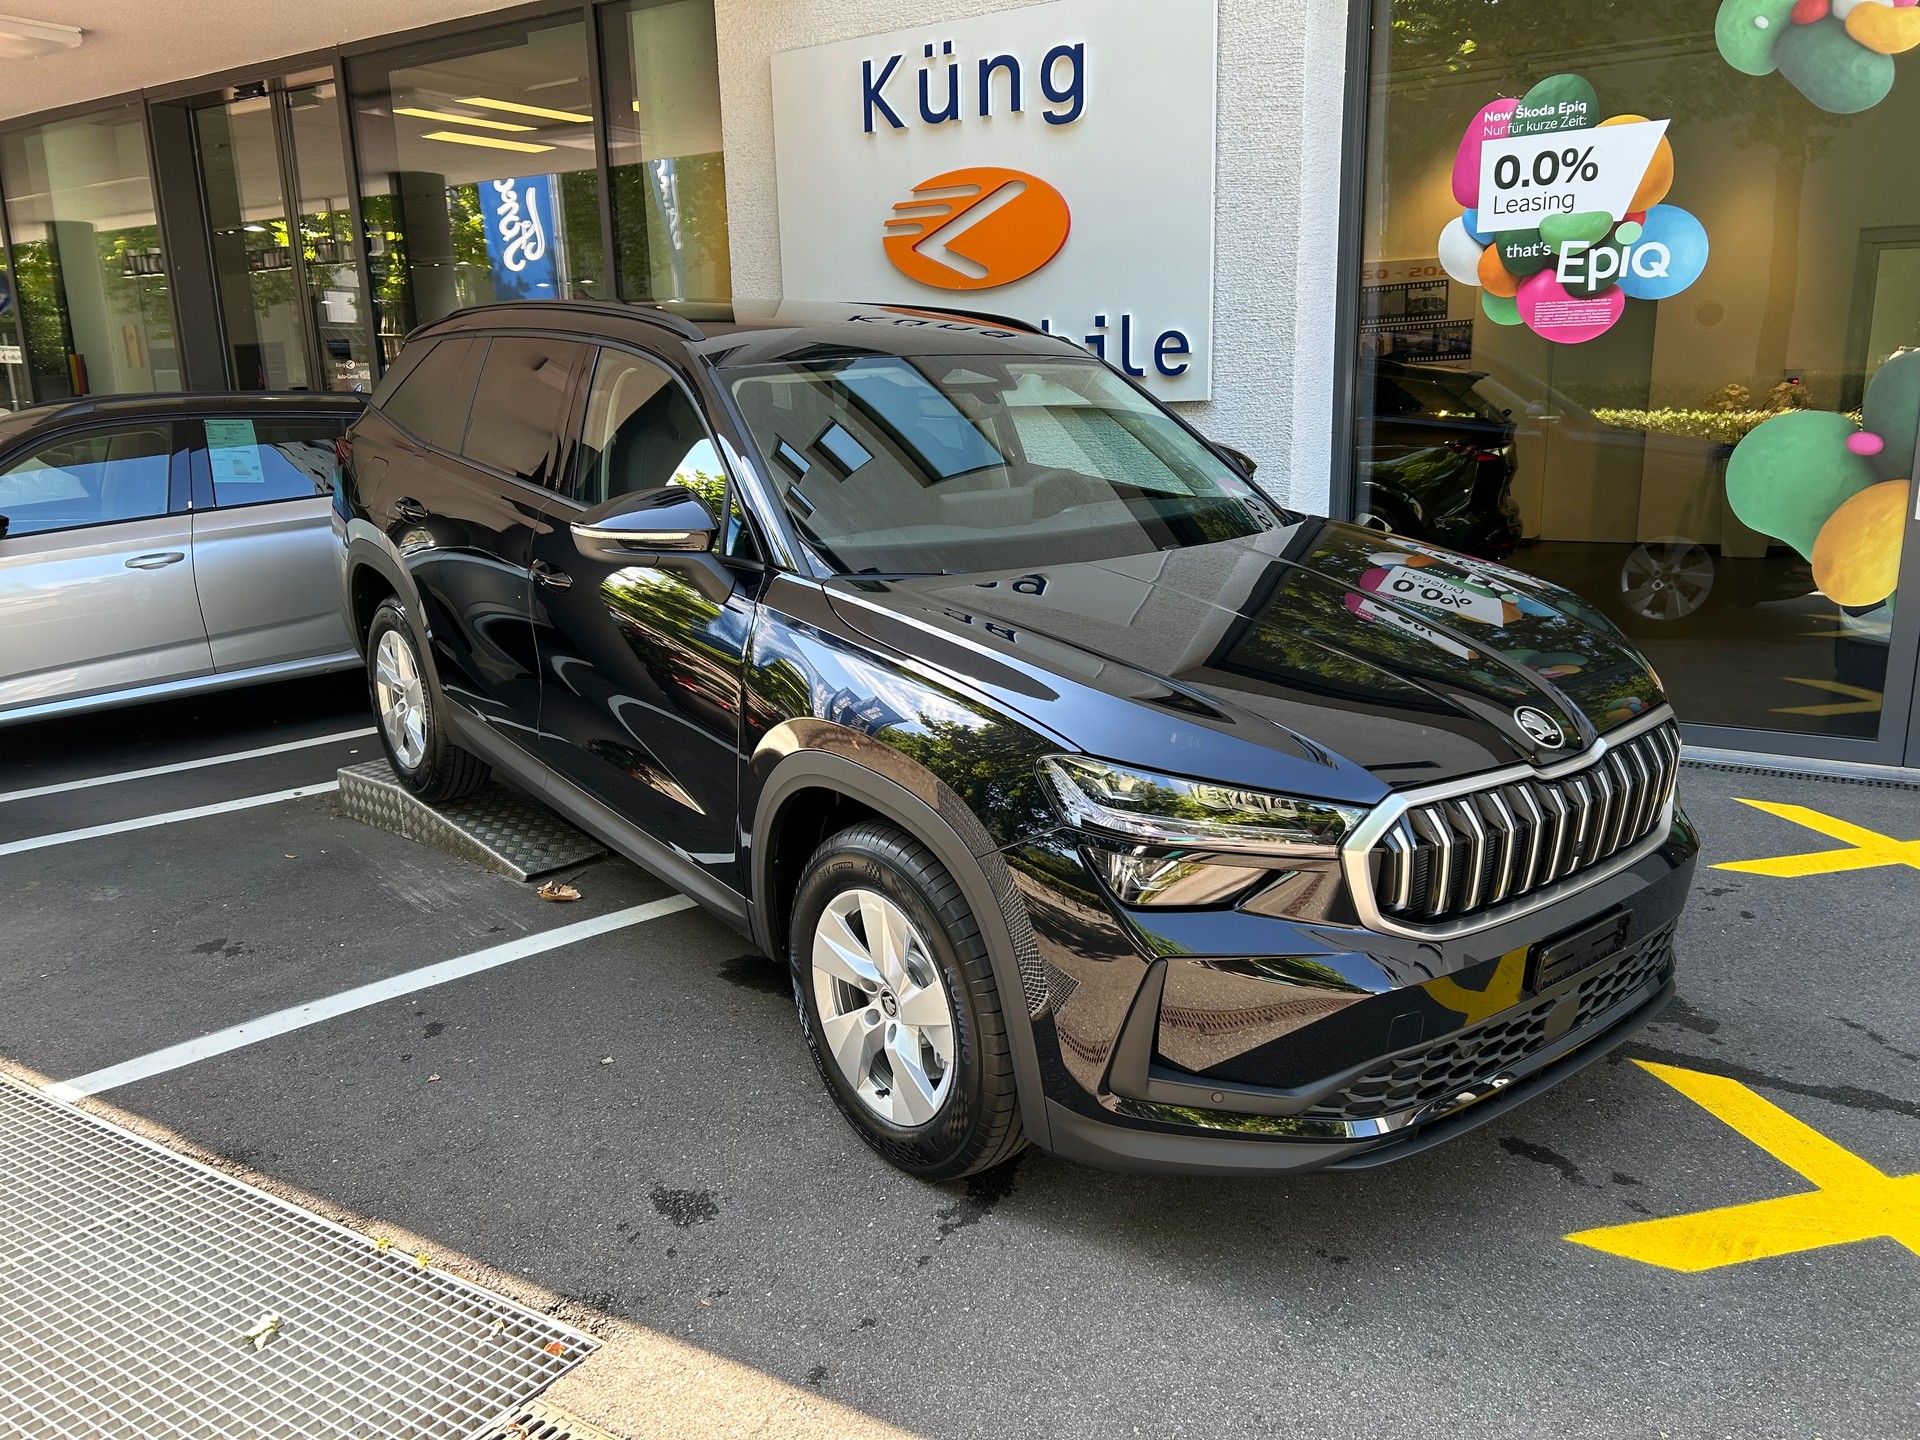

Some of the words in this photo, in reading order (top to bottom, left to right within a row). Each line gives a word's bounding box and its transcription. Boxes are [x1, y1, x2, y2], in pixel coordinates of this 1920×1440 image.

[862, 39, 1089, 134] Küng
[1484, 106, 1512, 123] New
[1515, 99, 1555, 119] Škoda
[1558, 100, 1588, 116] Epiq
[1483, 125, 1504, 137] Nur
[1507, 121, 1524, 134] für
[1526, 118, 1558, 132] kurze
[1560, 114, 1588, 128] Zeit:
[1493, 146, 1599, 190] 0.0%
[1493, 191, 1575, 215] Leasing
[1505, 241, 1552, 259] that's
[943, 966, 972, 1065] KUMHO
